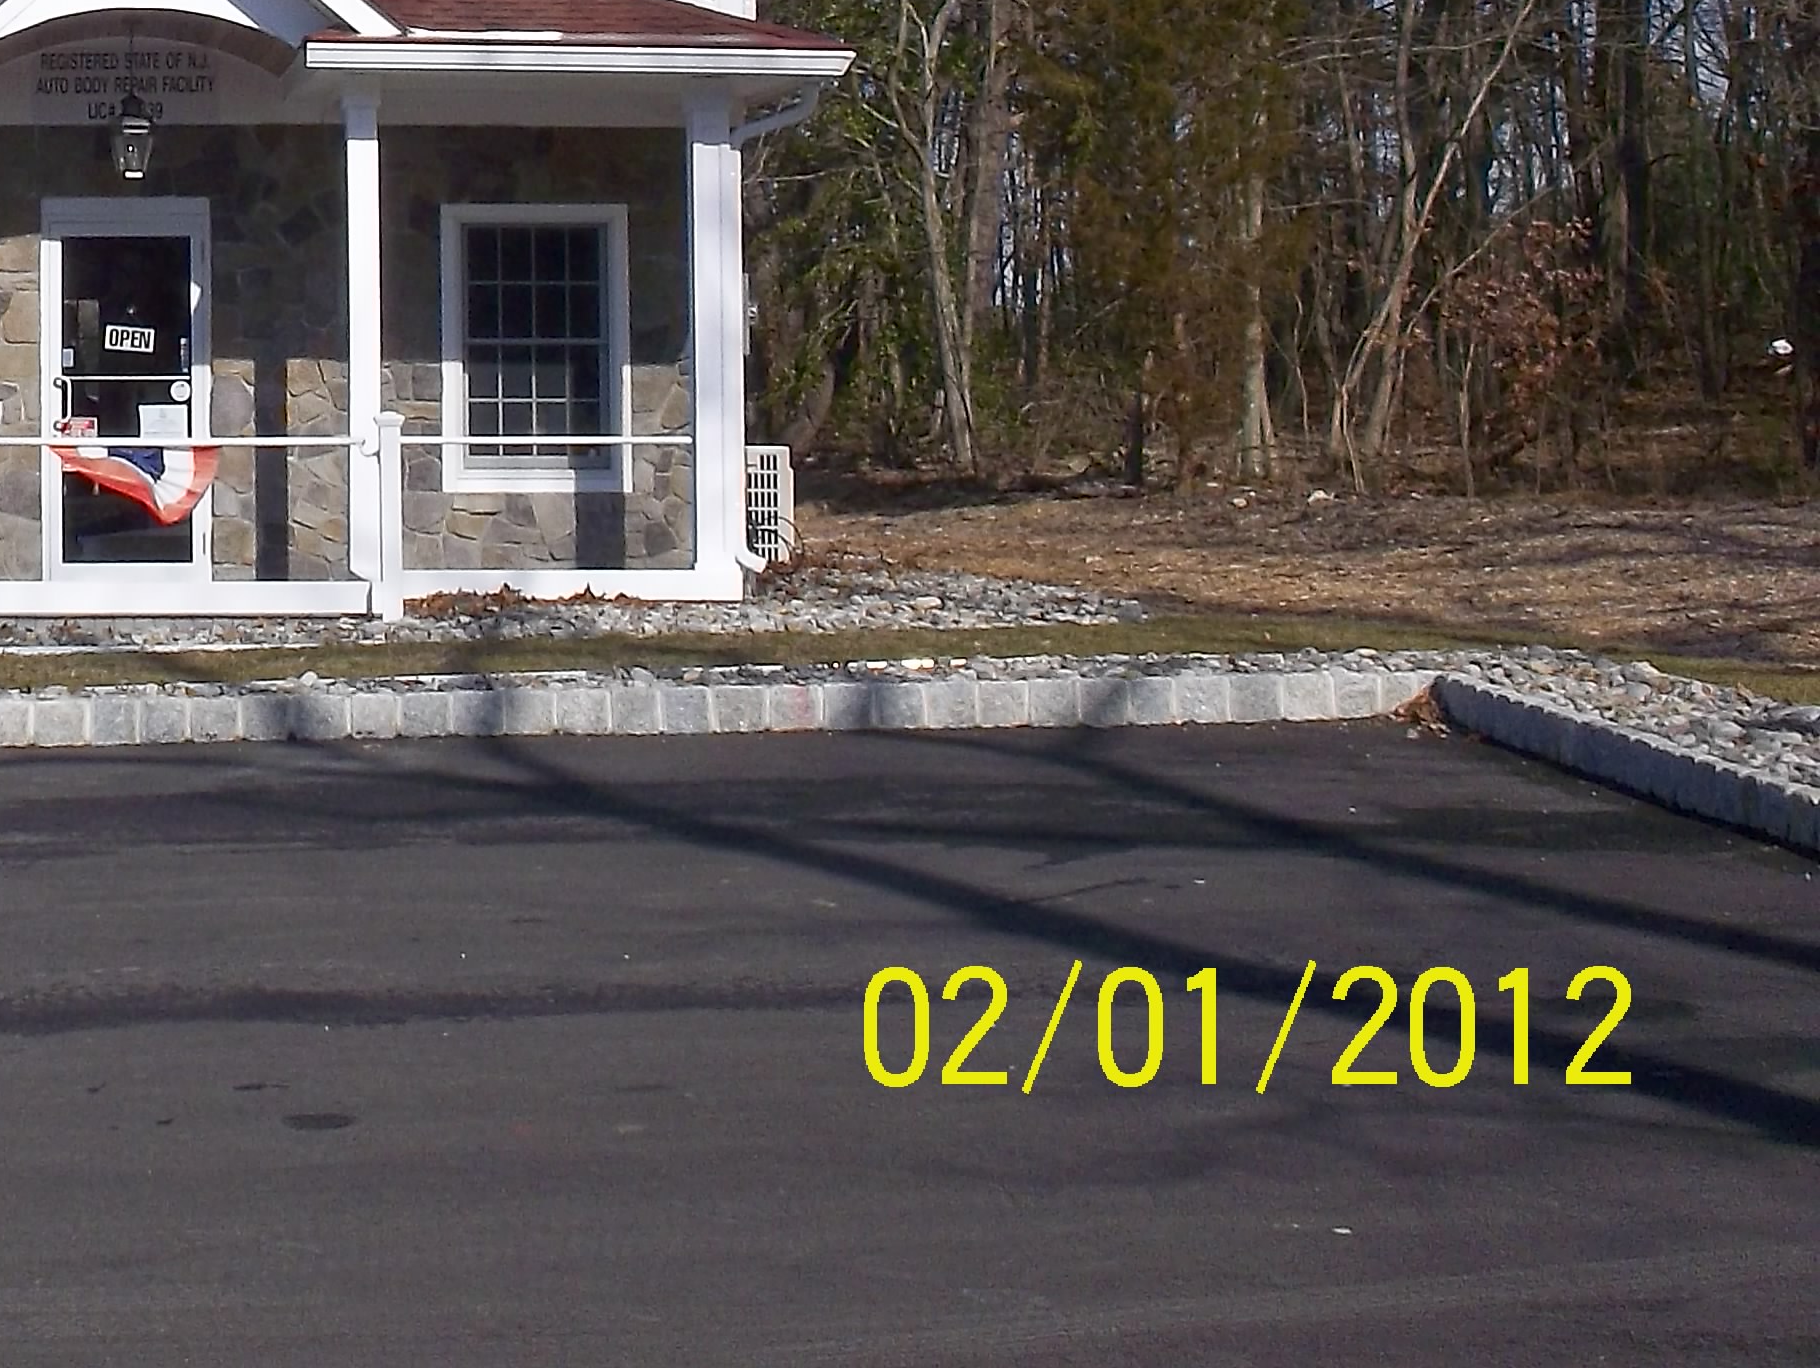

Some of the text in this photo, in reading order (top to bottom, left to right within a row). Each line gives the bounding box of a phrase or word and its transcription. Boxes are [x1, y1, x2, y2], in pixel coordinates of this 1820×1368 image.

[41, 52, 118, 70] REGISTERED
[124, 52, 160, 69] STATE
[166, 52, 183, 69] OF
[36, 76, 215, 94] AUTO BODY REPAIR FACILITY
[109, 328, 151, 349] OPEN
